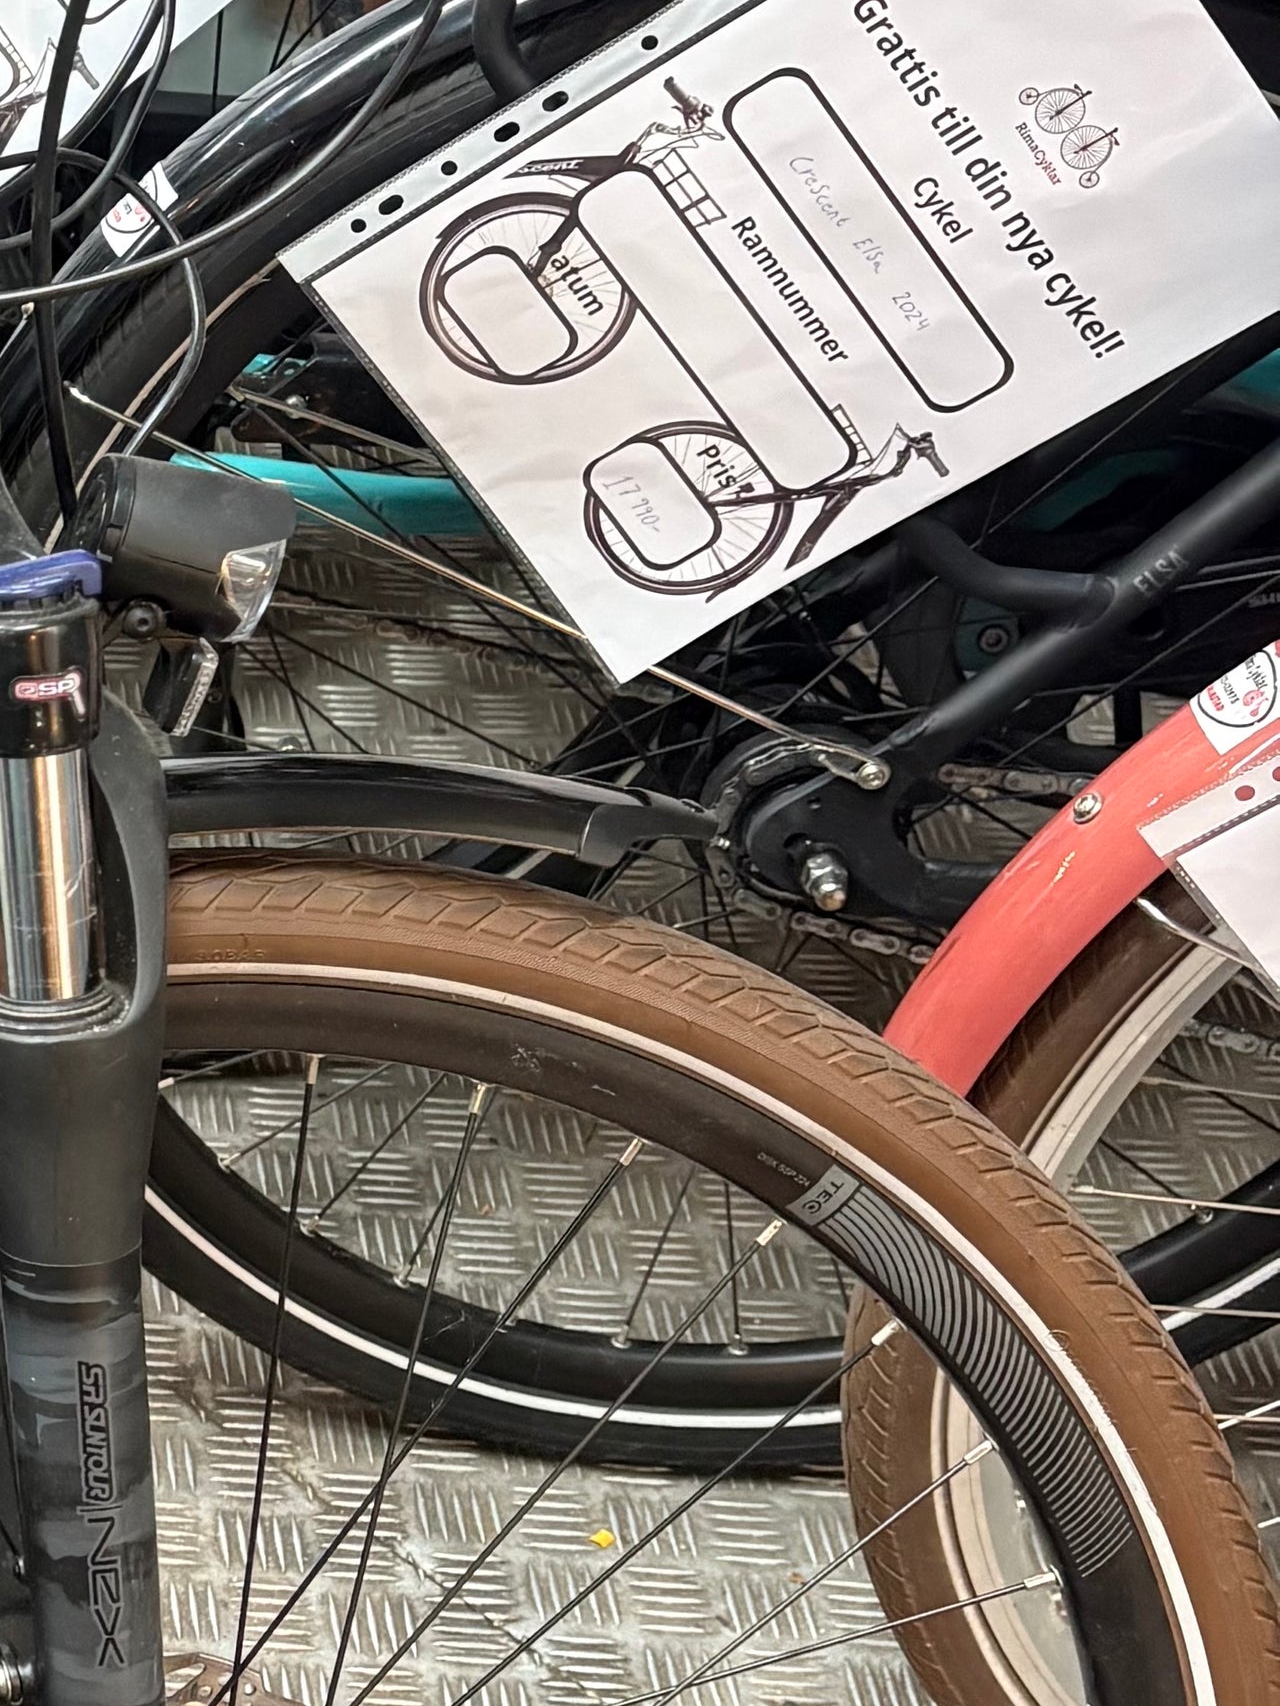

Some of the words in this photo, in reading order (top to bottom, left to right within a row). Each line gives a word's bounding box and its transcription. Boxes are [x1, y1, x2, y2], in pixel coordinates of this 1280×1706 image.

[1014, 121, 1062, 186] RimaCyklar
[913, 176, 974, 245] Cykel
[930, 104, 984, 156] till
[964, 156, 1013, 212] din
[1001, 210, 1055, 272] nya
[1043, 271, 1125, 360] cykel!
[550, 252, 604, 317] atum
[730, 215, 850, 365] Ramnummer
[890, 290, 932, 332] 2024
[695, 444, 738, 490] Pris
